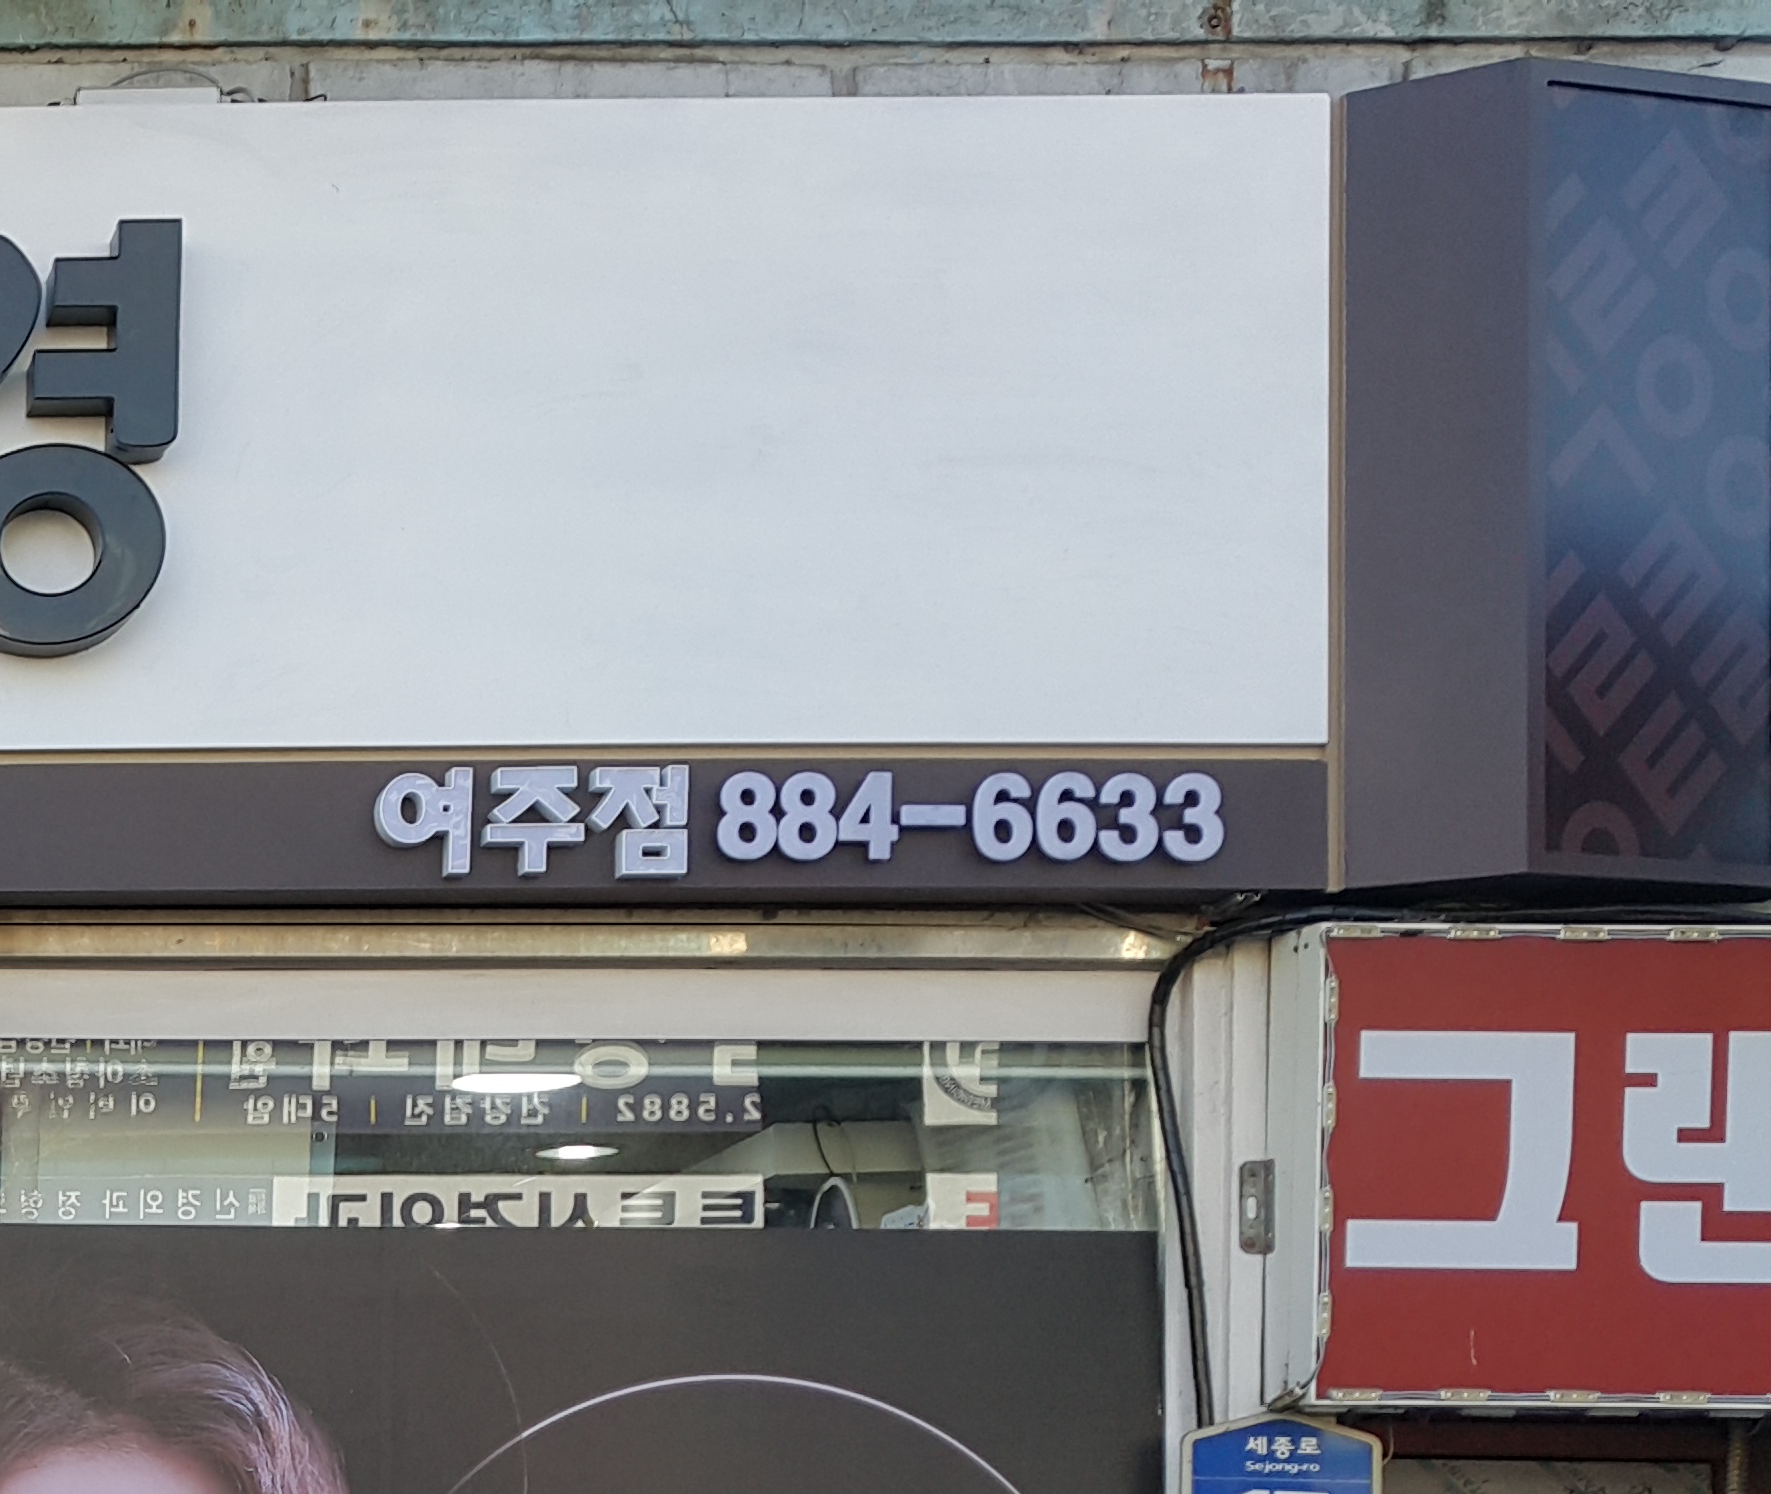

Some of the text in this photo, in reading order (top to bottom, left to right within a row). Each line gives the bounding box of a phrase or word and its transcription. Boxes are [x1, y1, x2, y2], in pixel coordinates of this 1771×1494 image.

[374, 765, 1226, 881] 여주점 884-6633
[1244, 1435, 1322, 1460] 세종로
[1244, 1460, 1321, 1474] Sejong-ro
